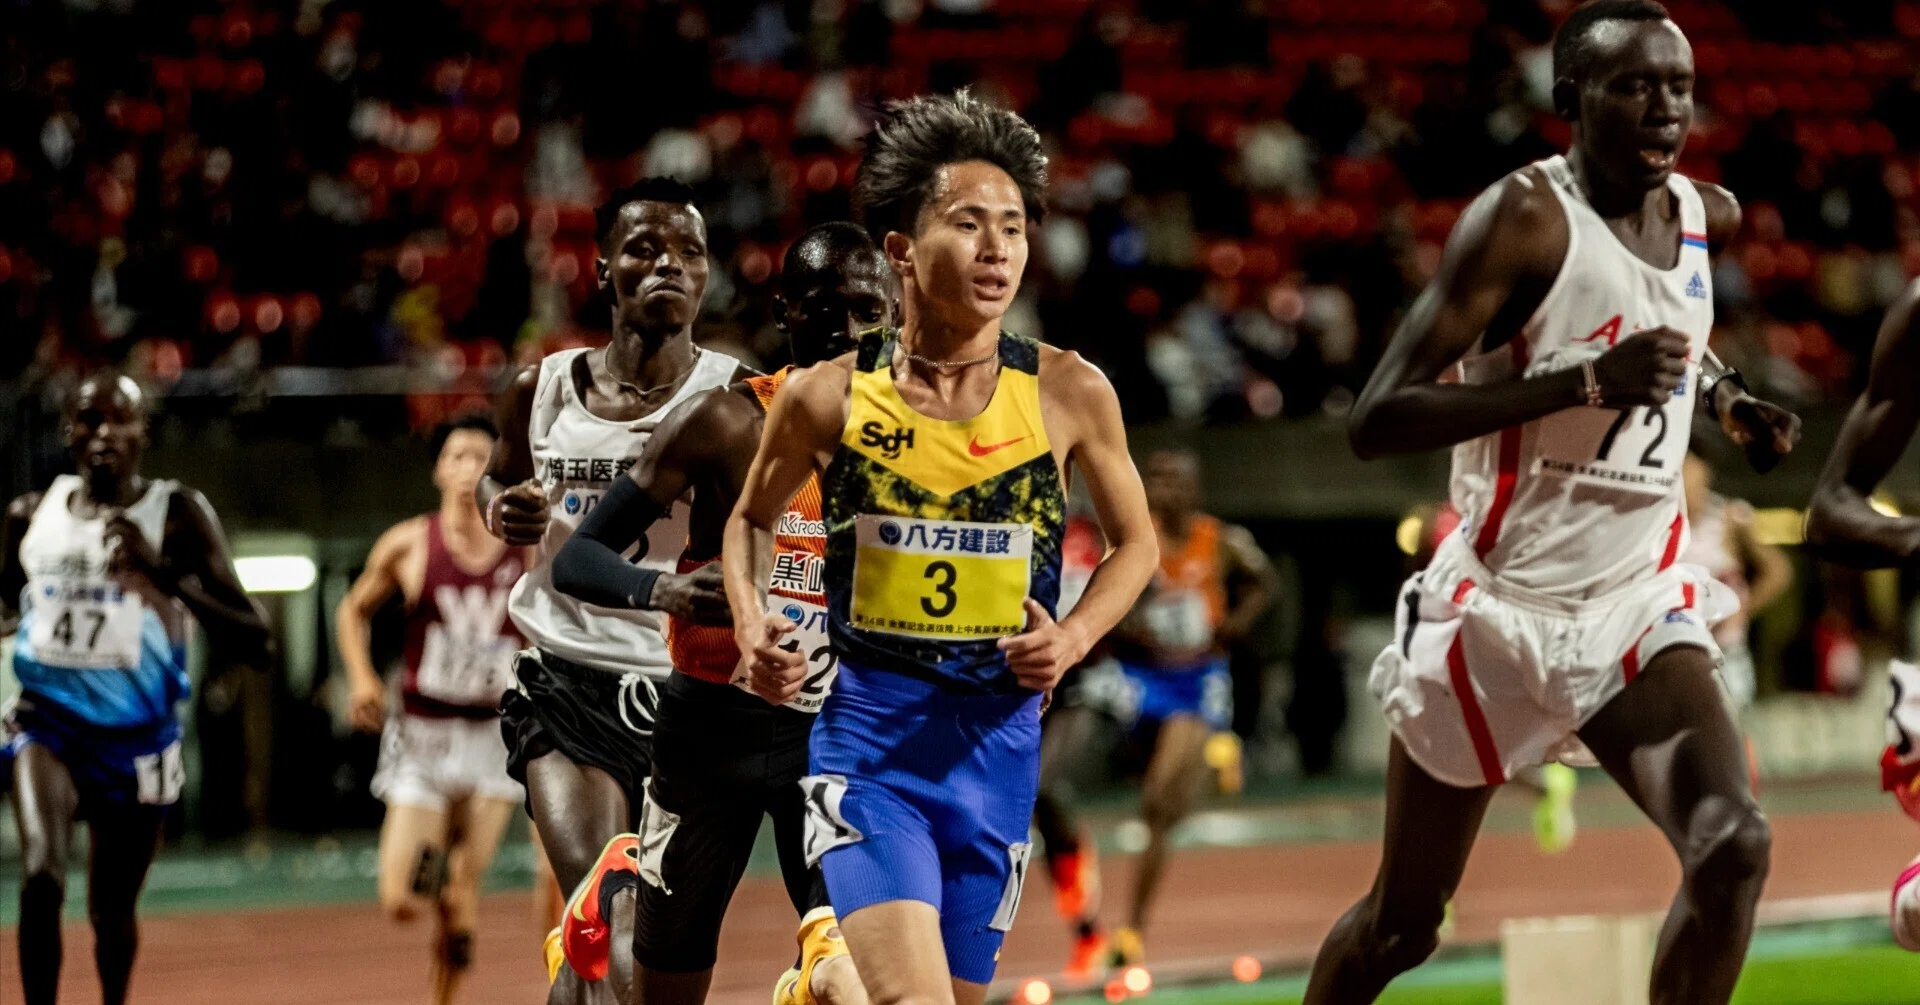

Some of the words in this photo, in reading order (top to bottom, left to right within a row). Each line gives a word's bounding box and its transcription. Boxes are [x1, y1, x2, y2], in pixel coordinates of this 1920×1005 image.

[1596, 404, 1668, 468] 72
[904, 523, 1012, 555] 八方建設
[919, 560, 958, 619] 3
[53, 608, 106, 649] 47
